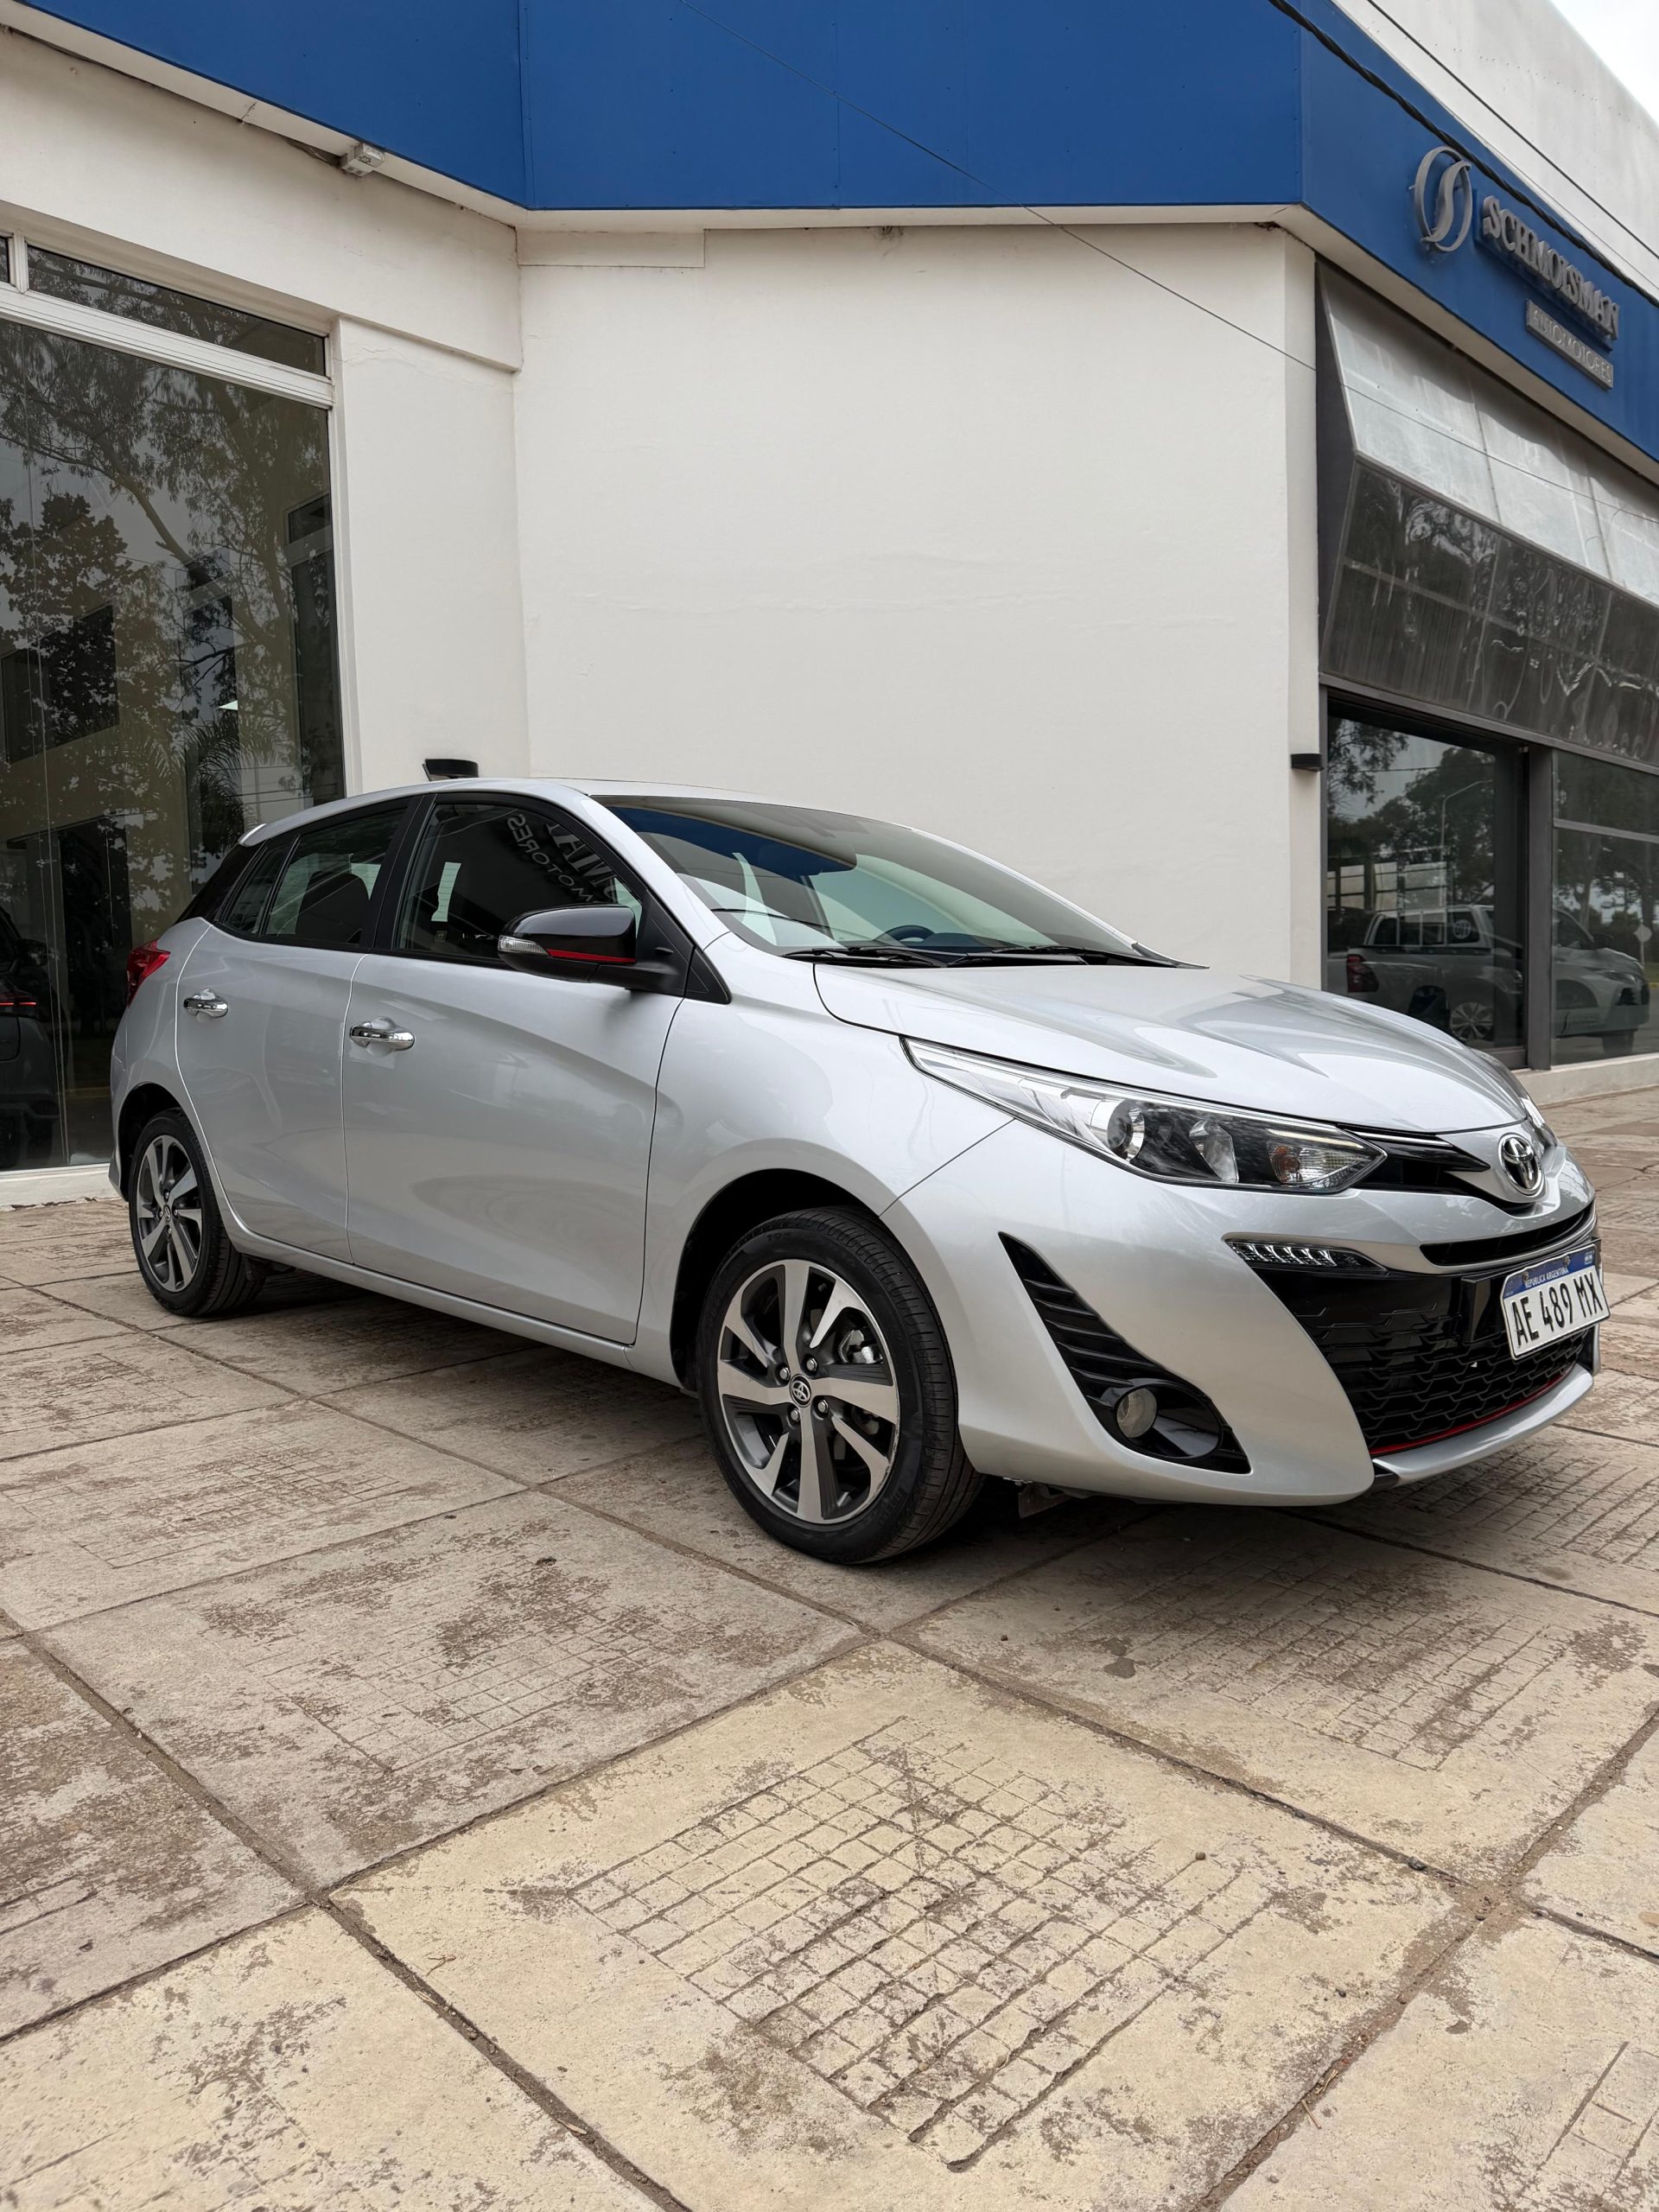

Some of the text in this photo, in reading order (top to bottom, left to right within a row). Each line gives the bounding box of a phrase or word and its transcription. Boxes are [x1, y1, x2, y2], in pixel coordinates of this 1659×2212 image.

[1483, 195, 1619, 340] SCHMOLSMAN
[1532, 308, 1612, 384] AUTOMOTORES
[1511, 1272, 1604, 1347] AE 489 MX
[1547, 1266, 1569, 1280] ARGENTINA
